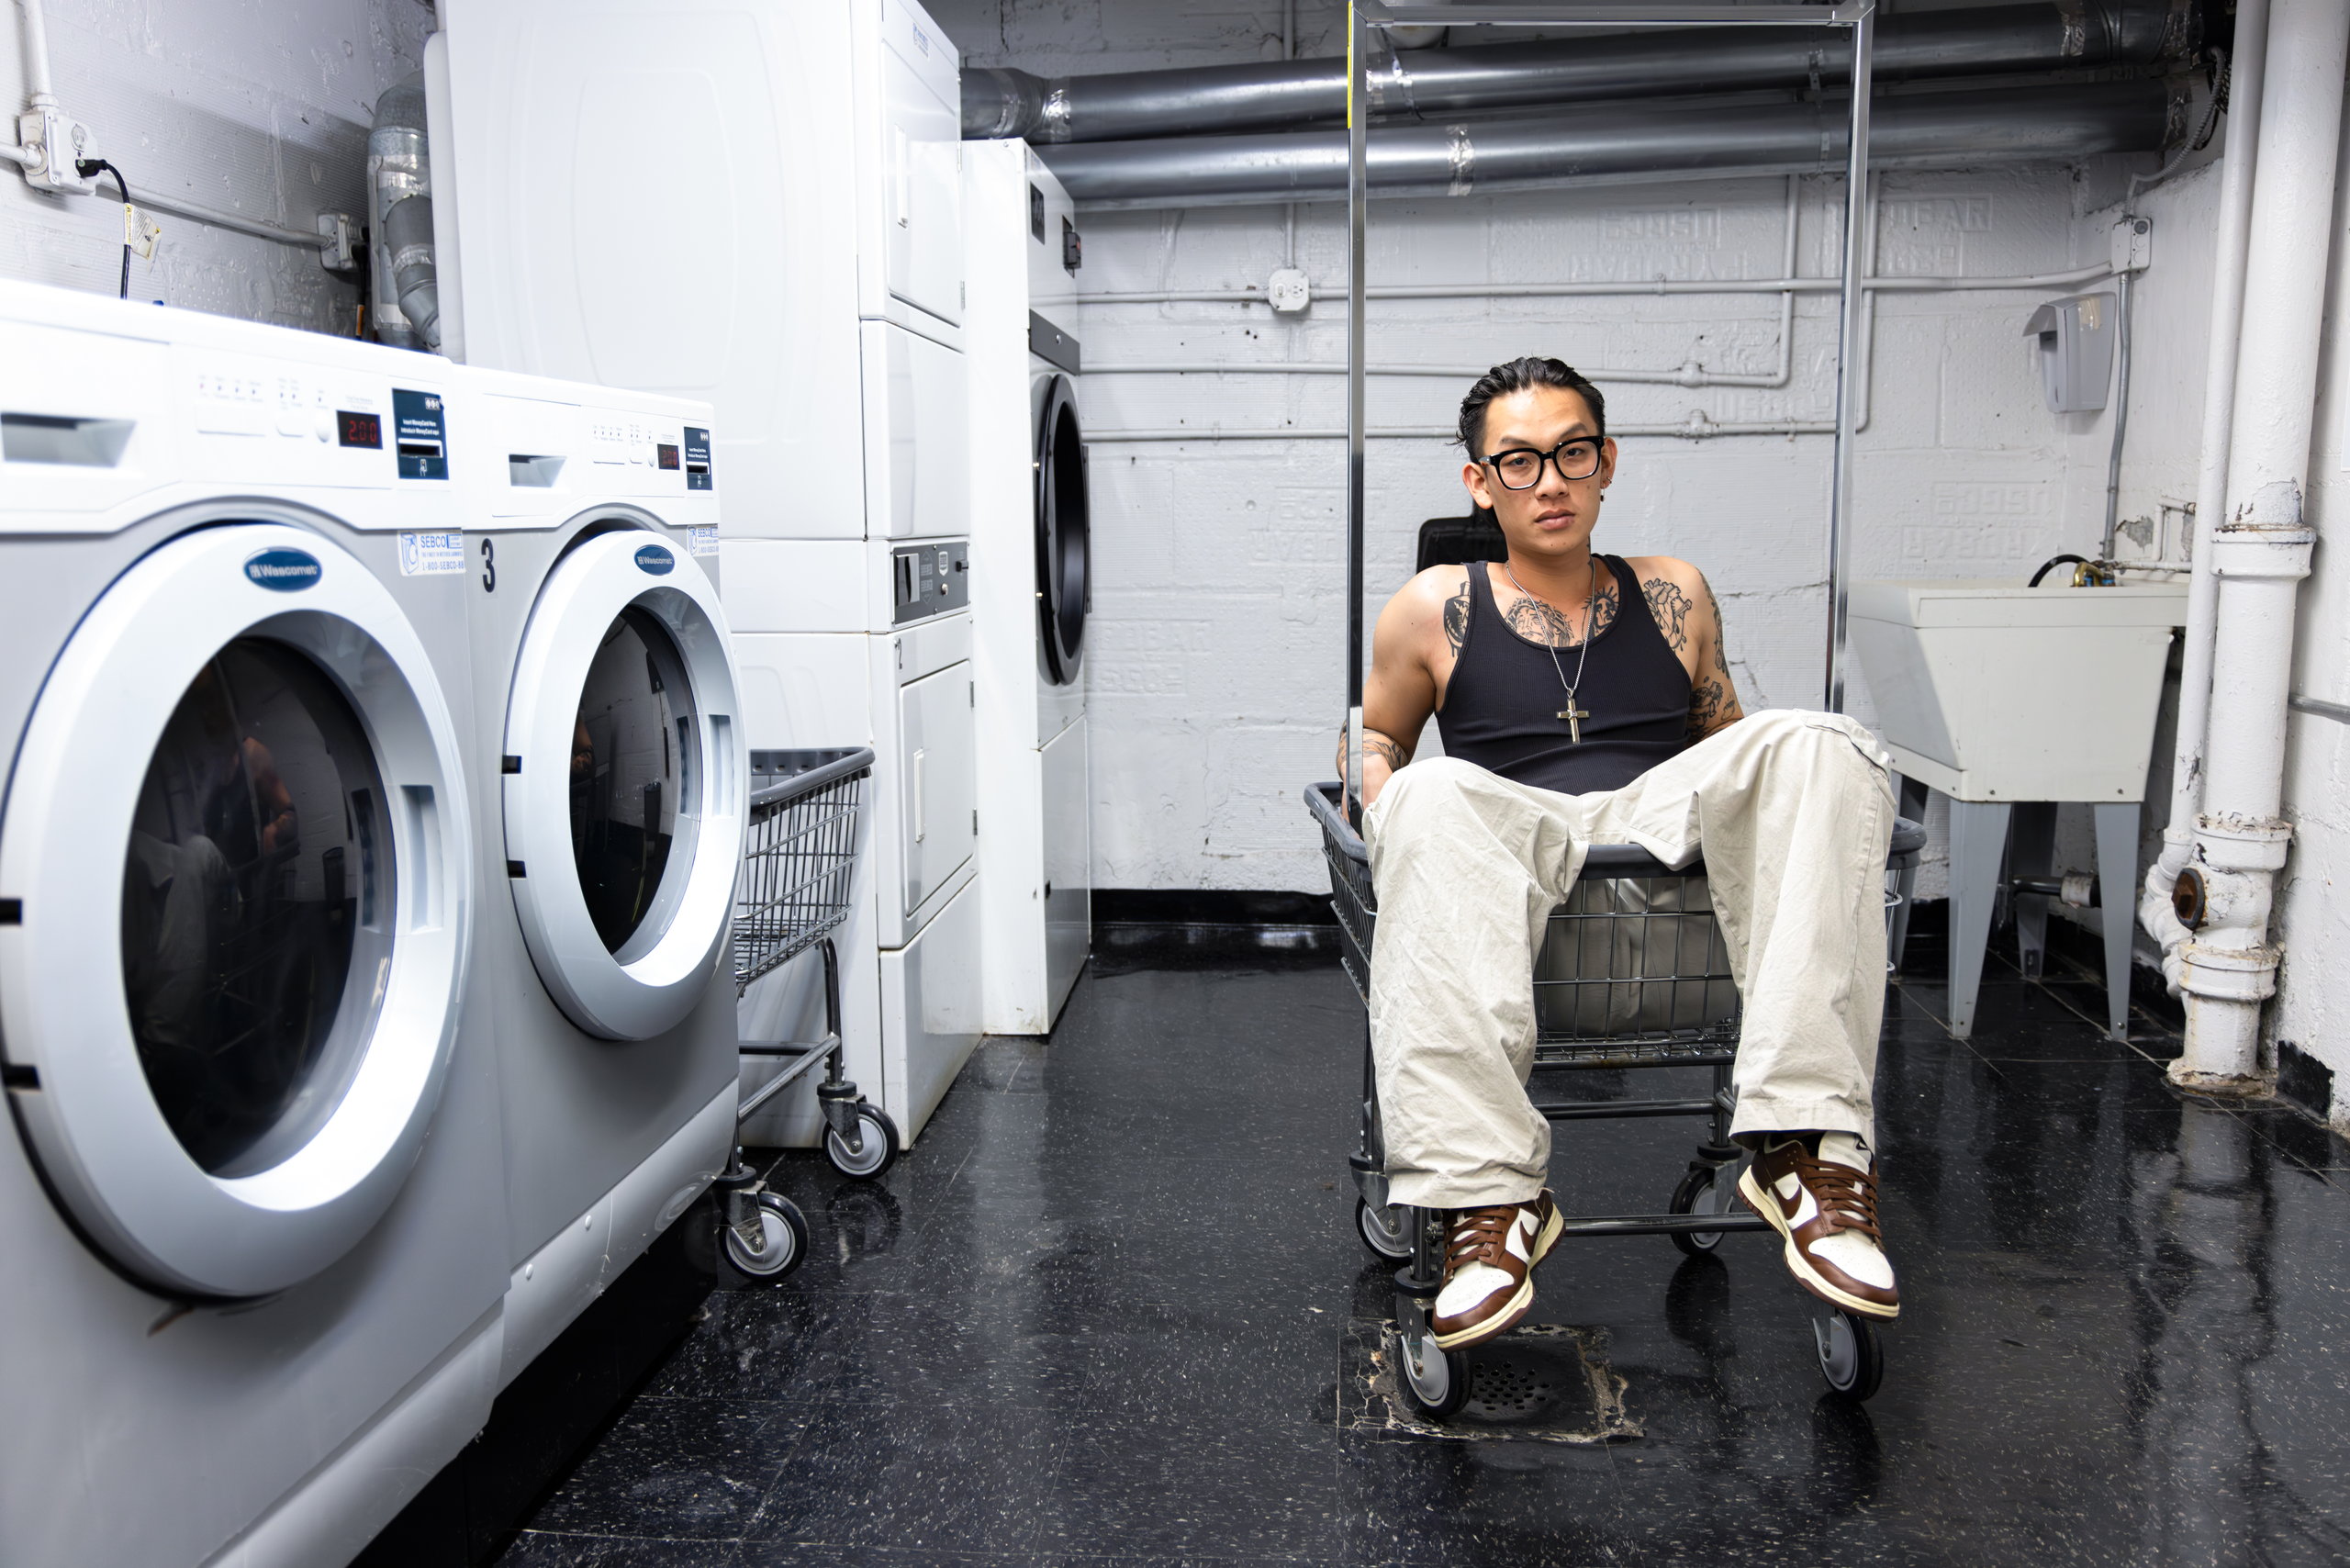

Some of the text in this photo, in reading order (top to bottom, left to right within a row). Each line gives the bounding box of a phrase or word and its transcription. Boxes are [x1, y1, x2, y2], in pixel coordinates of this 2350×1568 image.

[420, 535, 446, 548] SEBCO
[260, 564, 318, 577] Wascomat
[481, 538, 496, 593] 3
